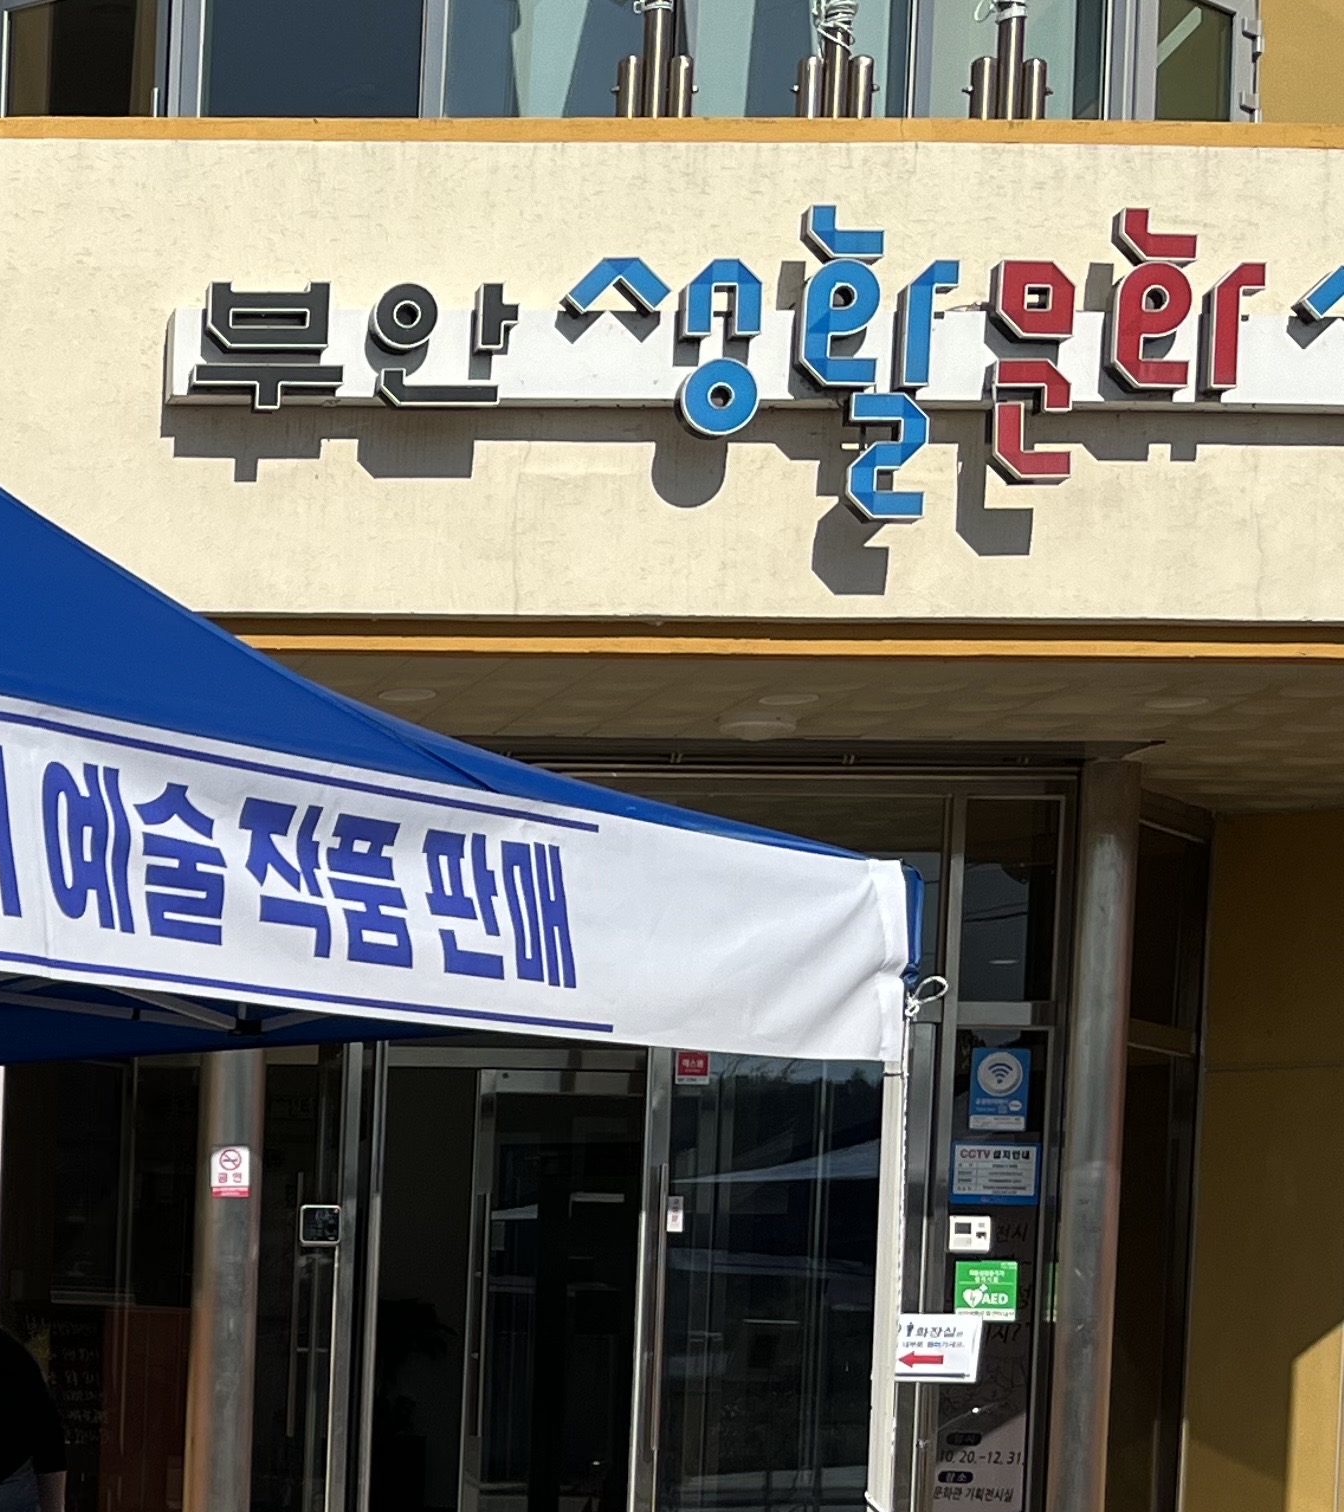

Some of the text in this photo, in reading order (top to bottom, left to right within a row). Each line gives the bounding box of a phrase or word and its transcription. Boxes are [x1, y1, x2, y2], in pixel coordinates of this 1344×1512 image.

[189, 203, 1344, 523] 부안 생활문화
[43, 756, 225, 946] 예술
[424, 825, 576, 989] 판매
[960, 1149, 990, 1161] CCTV
[981, 1293, 1009, 1305] AED
